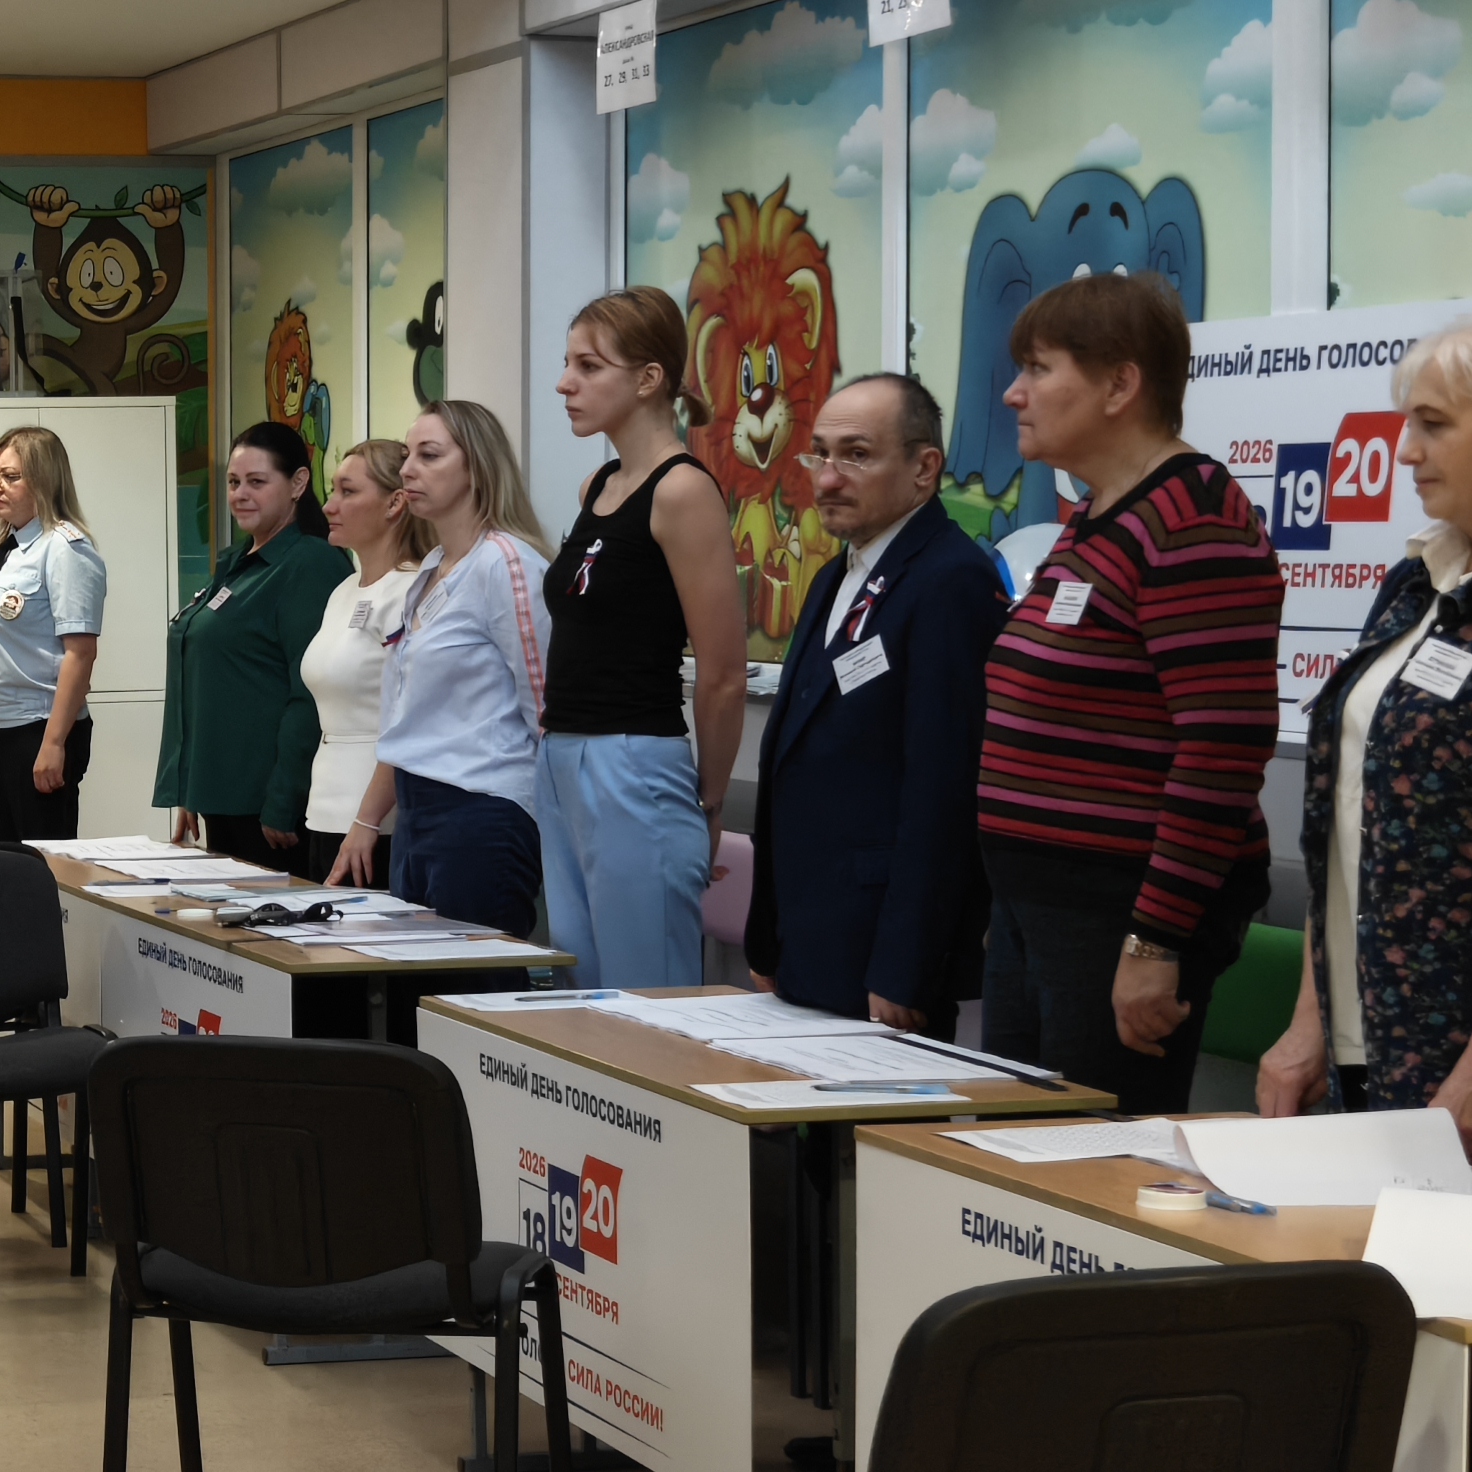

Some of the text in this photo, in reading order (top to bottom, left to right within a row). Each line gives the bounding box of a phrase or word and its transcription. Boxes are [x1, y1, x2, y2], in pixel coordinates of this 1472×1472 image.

[1187, 338, 1417, 383] ДИНЫЙ ДЕНЬ ГОЛОСО
[1227, 439, 1273, 465] 2026
[1331, 436, 1391, 498] 20
[1279, 468, 1322, 529] 19
[1279, 562, 1387, 590] СЕНТЯБРЯ
[1292, 652, 1339, 680] СИЛ
[138, 936, 244, 994] ЕДИНЫЙ ДЕНЬ ГОЛОСОВАНИЯ
[161, 1007, 179, 1030] 2026
[479, 1052, 662, 1144] ЕДИНЫЙ ДЕНЬ ГОЛОСОВАНИЯ
[518, 1146, 547, 1178] 2026
[522, 1178, 616, 1259] 18 19 20
[961, 1206, 1106, 1275] ЕДИНЫЙ ДЕНЬ
[555, 1272, 620, 1326] СЕНТЯБРЯ
[567, 1358, 664, 1433] СИЛА РОССИИ!
